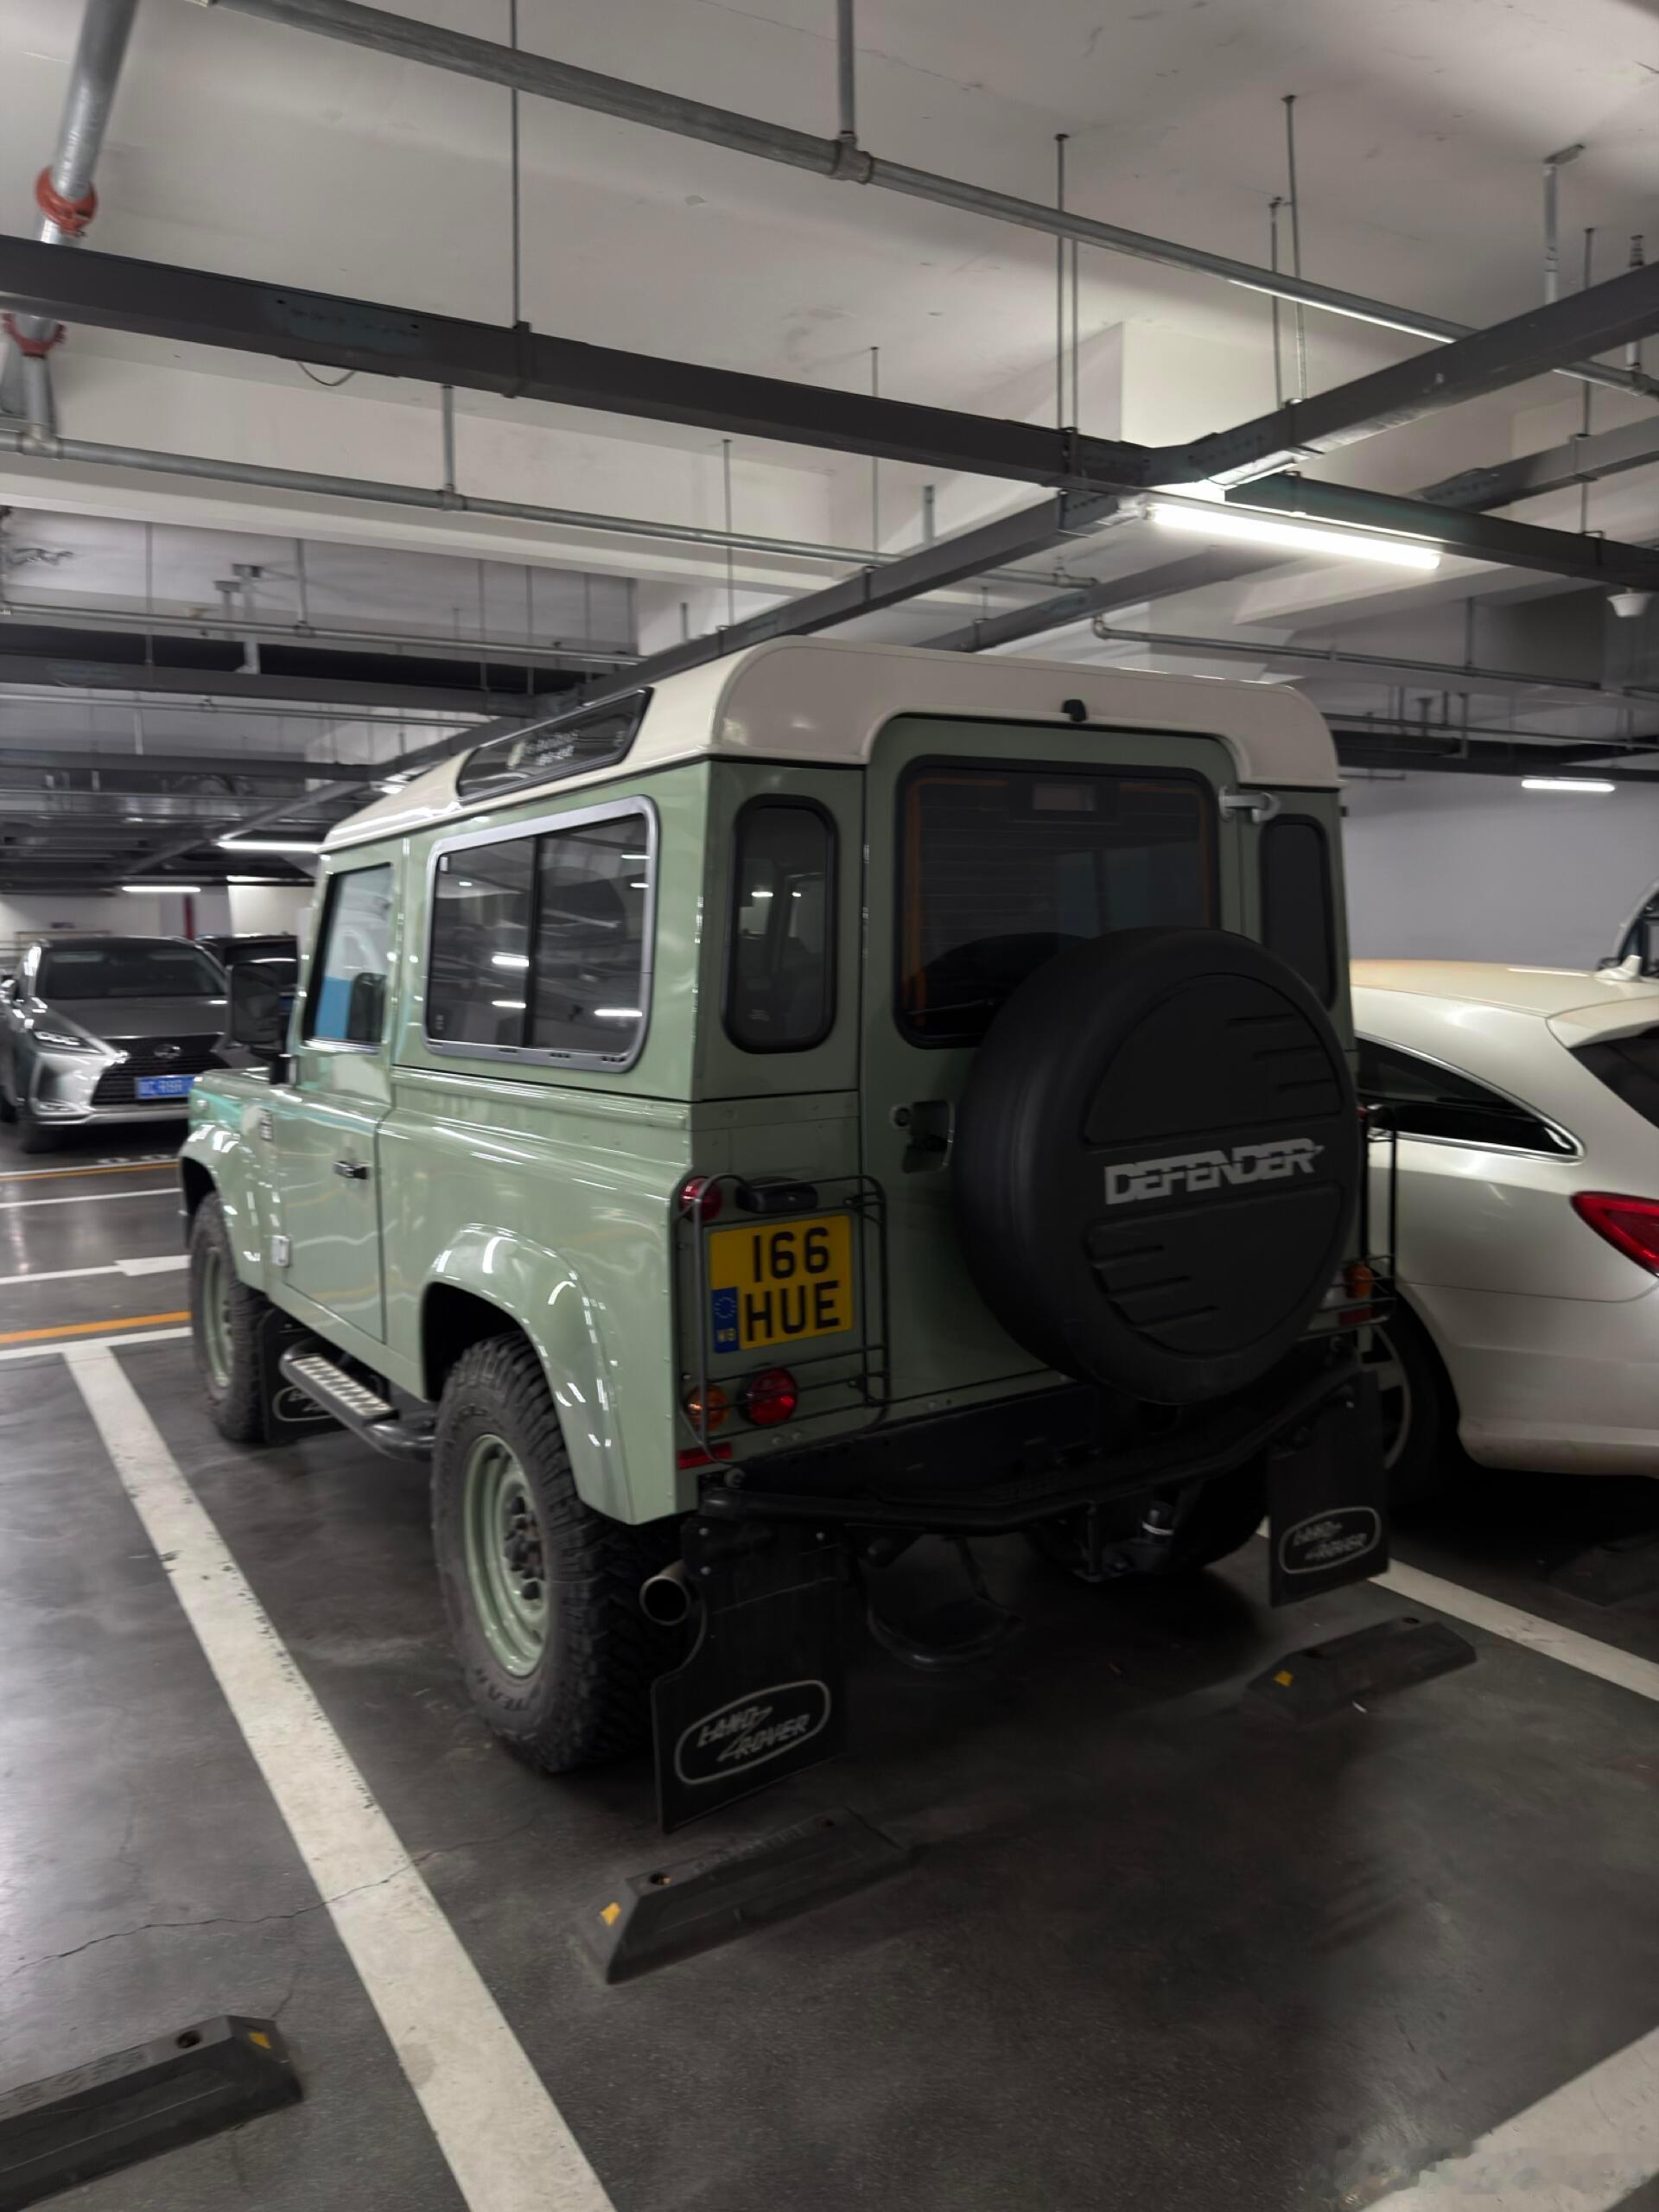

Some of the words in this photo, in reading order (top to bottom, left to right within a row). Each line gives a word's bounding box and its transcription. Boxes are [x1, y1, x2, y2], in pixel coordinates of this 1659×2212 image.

[1105, 1138, 1325, 1205] DEFENDER
[753, 1226, 830, 1283] 166
[744, 1280, 841, 1342] HUE
[719, 1713, 810, 1761] ROVER
